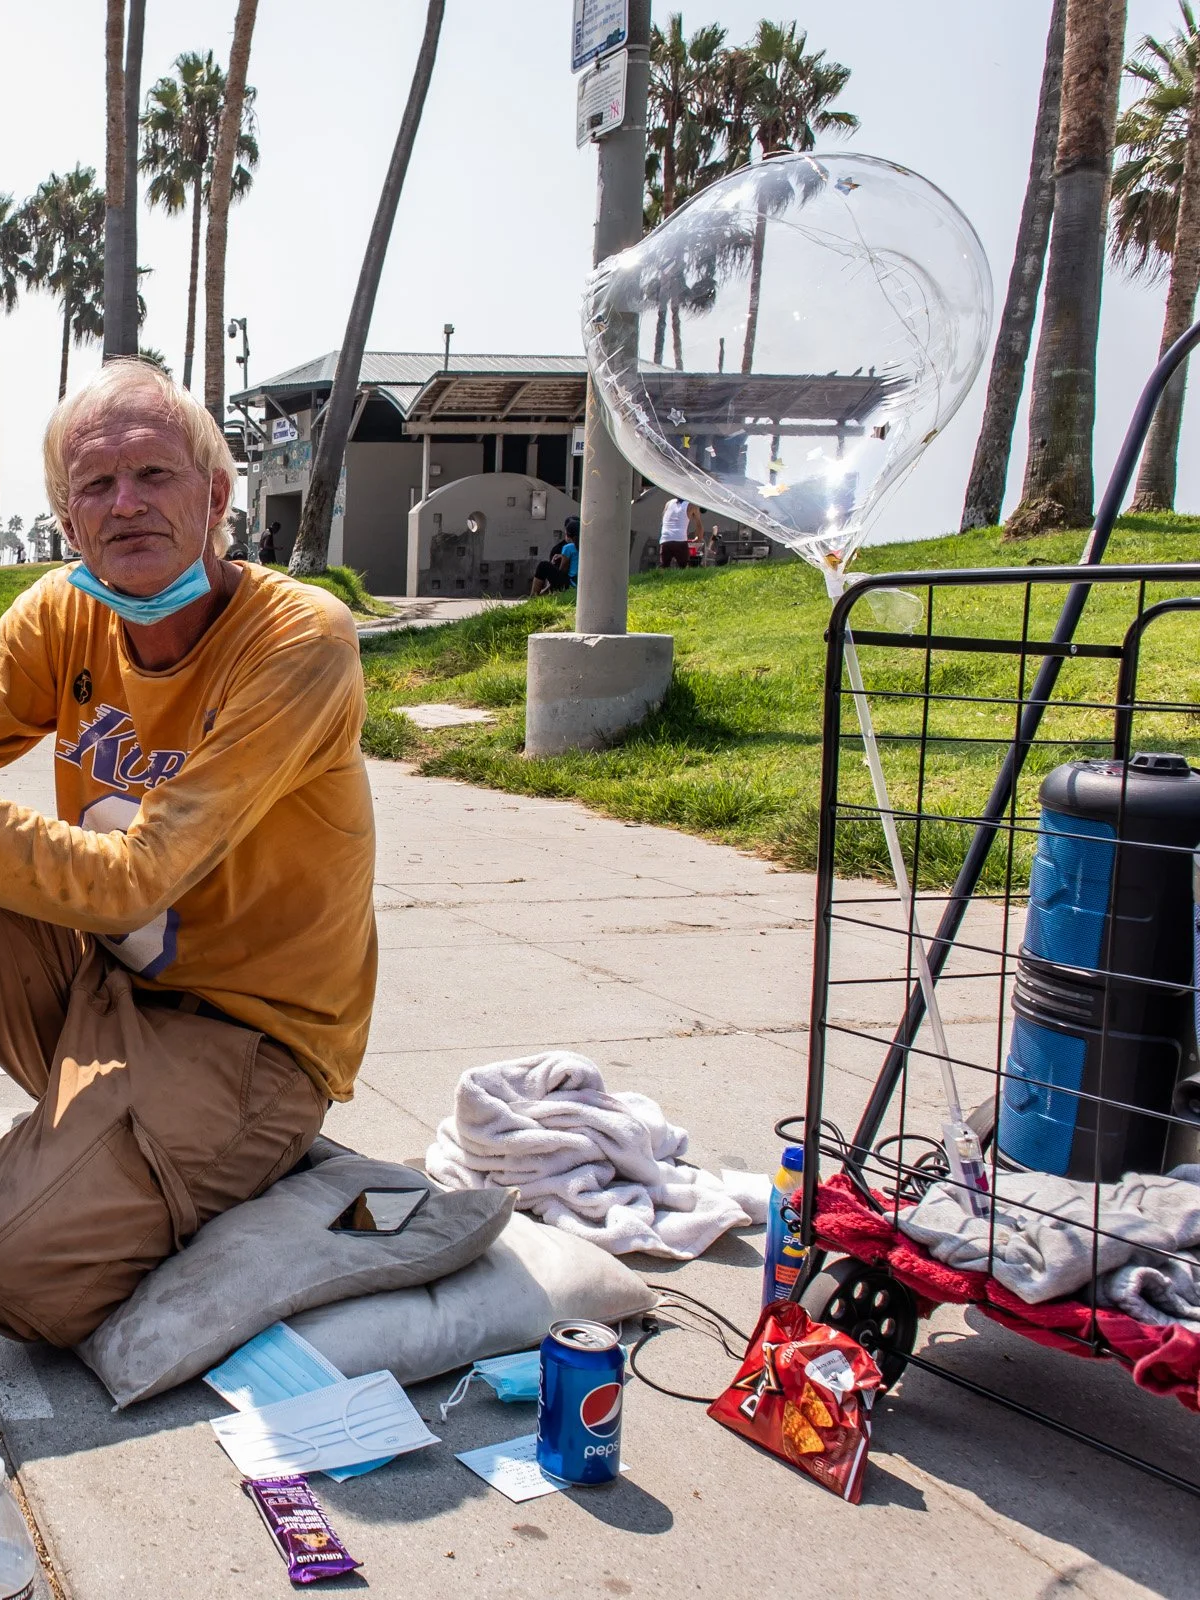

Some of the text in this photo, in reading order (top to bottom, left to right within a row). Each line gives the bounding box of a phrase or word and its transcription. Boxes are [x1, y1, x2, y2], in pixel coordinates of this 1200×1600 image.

[583, 1440, 620, 1459] peps
[276, 1516, 305, 1525] COOKIE
[285, 1522, 327, 1530] CHOCOLATE
[296, 1553, 343, 1563] KIRKLAND
